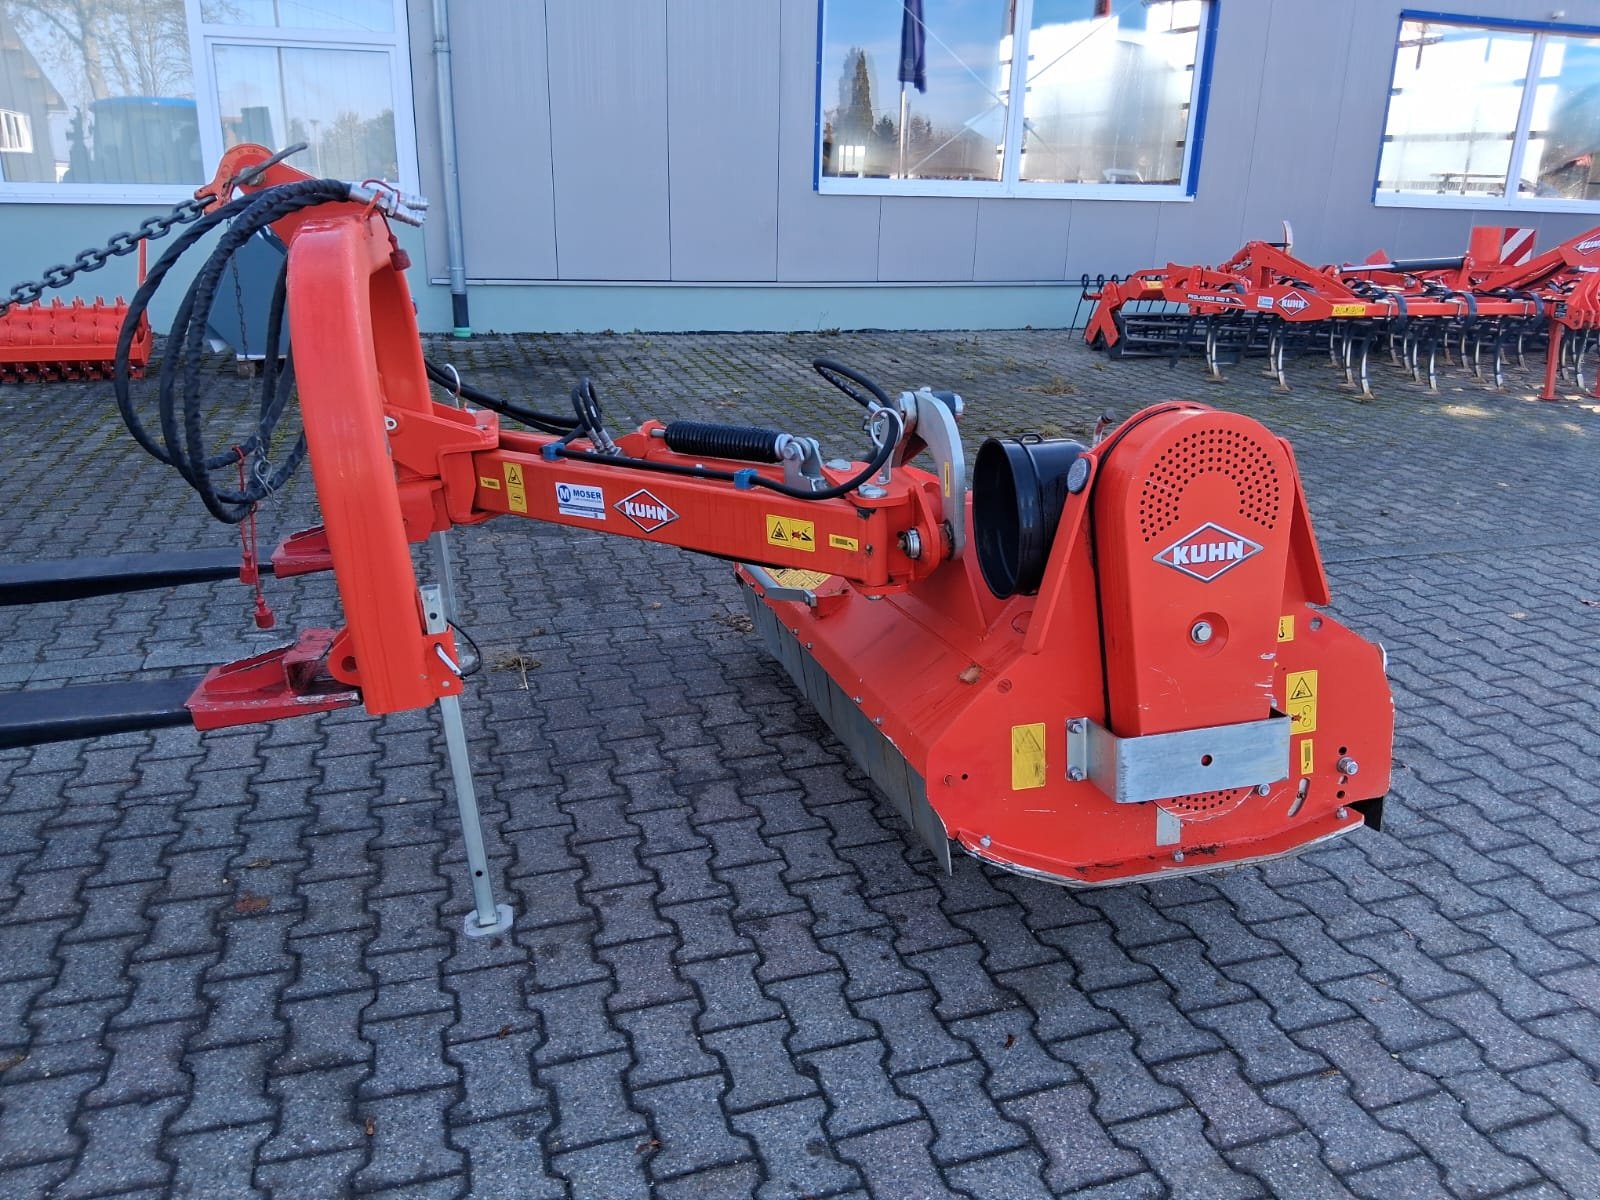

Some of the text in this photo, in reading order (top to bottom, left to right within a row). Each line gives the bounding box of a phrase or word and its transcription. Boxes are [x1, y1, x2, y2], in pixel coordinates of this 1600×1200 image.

[1281, 299, 1305, 309] KUHN
[573, 489, 602, 500] MOSER
[624, 501, 668, 520] KUHN
[1173, 541, 1243, 565] KUHN
